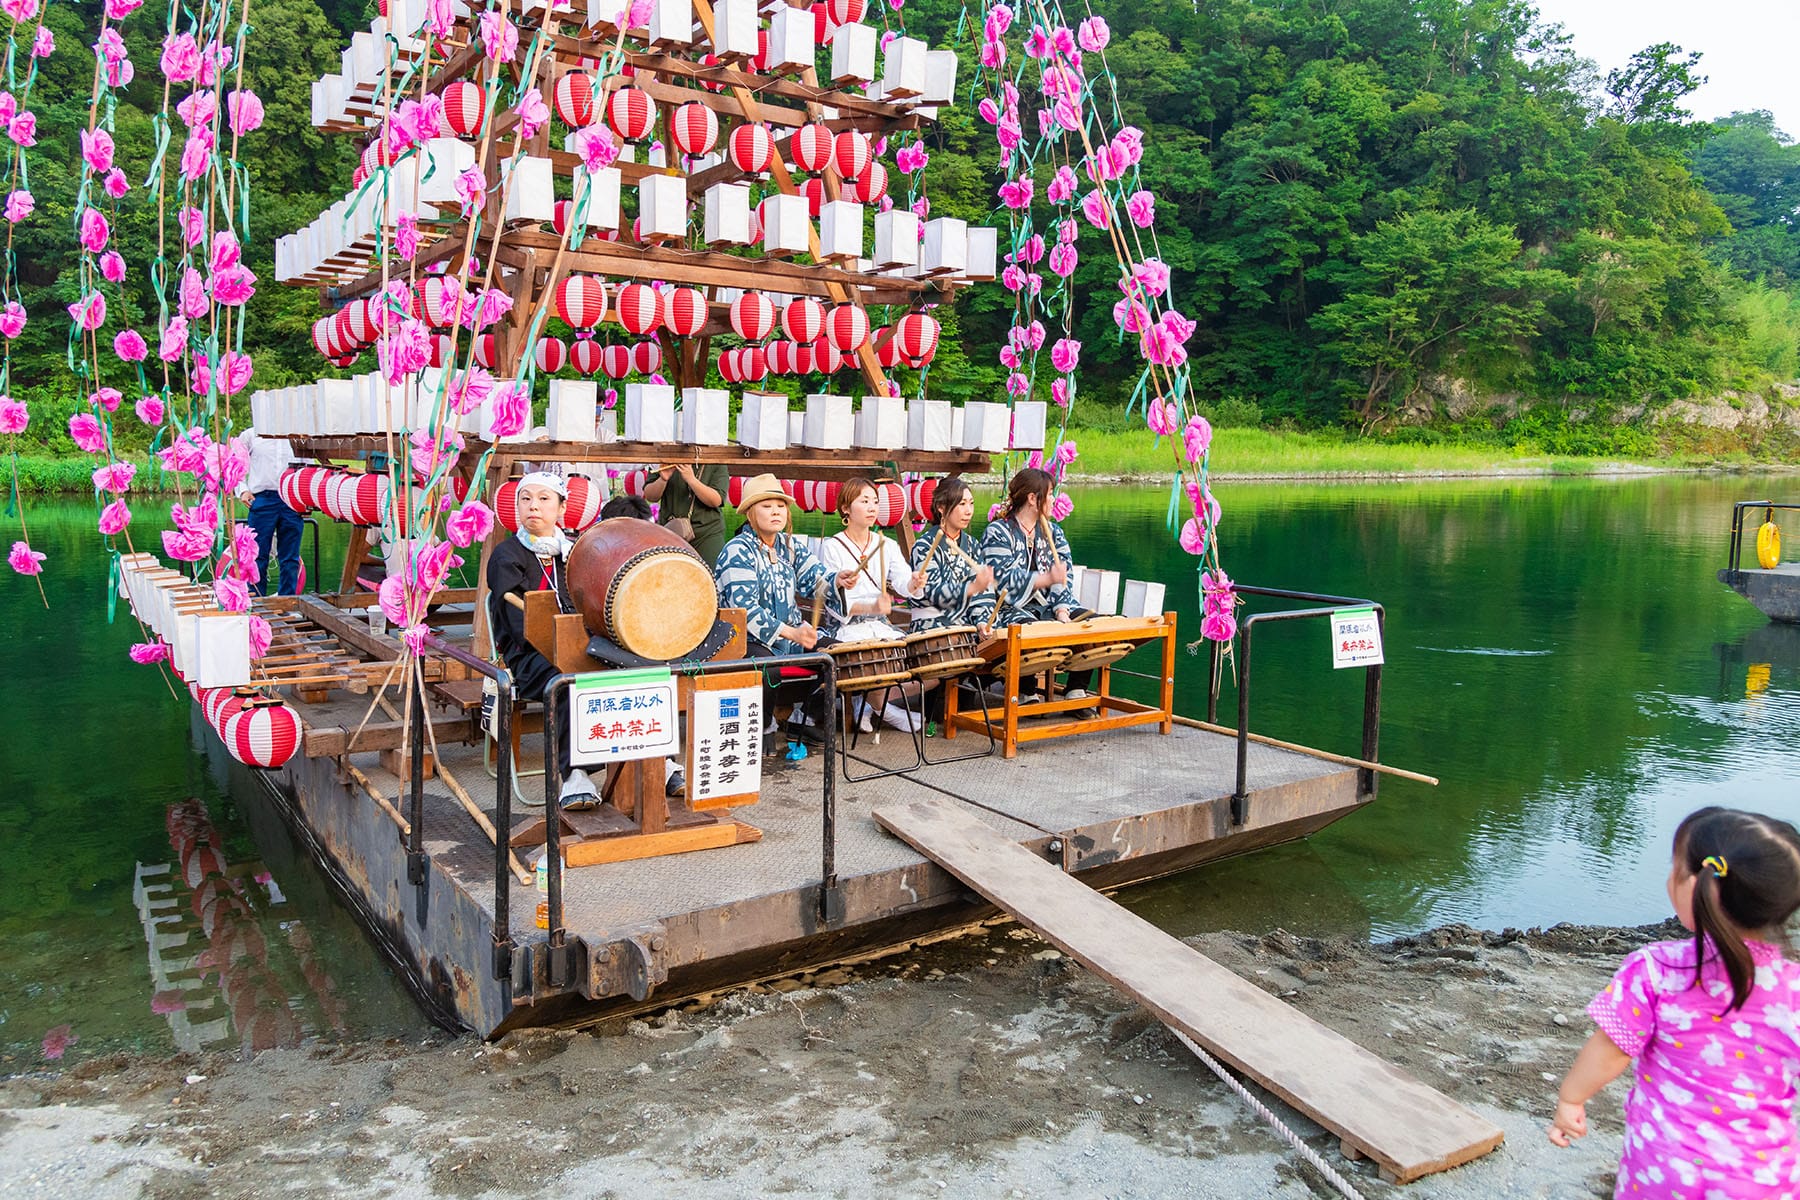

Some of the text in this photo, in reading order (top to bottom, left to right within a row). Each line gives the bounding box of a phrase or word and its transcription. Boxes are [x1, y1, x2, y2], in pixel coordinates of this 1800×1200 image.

[586, 693, 664, 715] 関係者以外
[588, 718, 662, 741] 乗舟禁止
